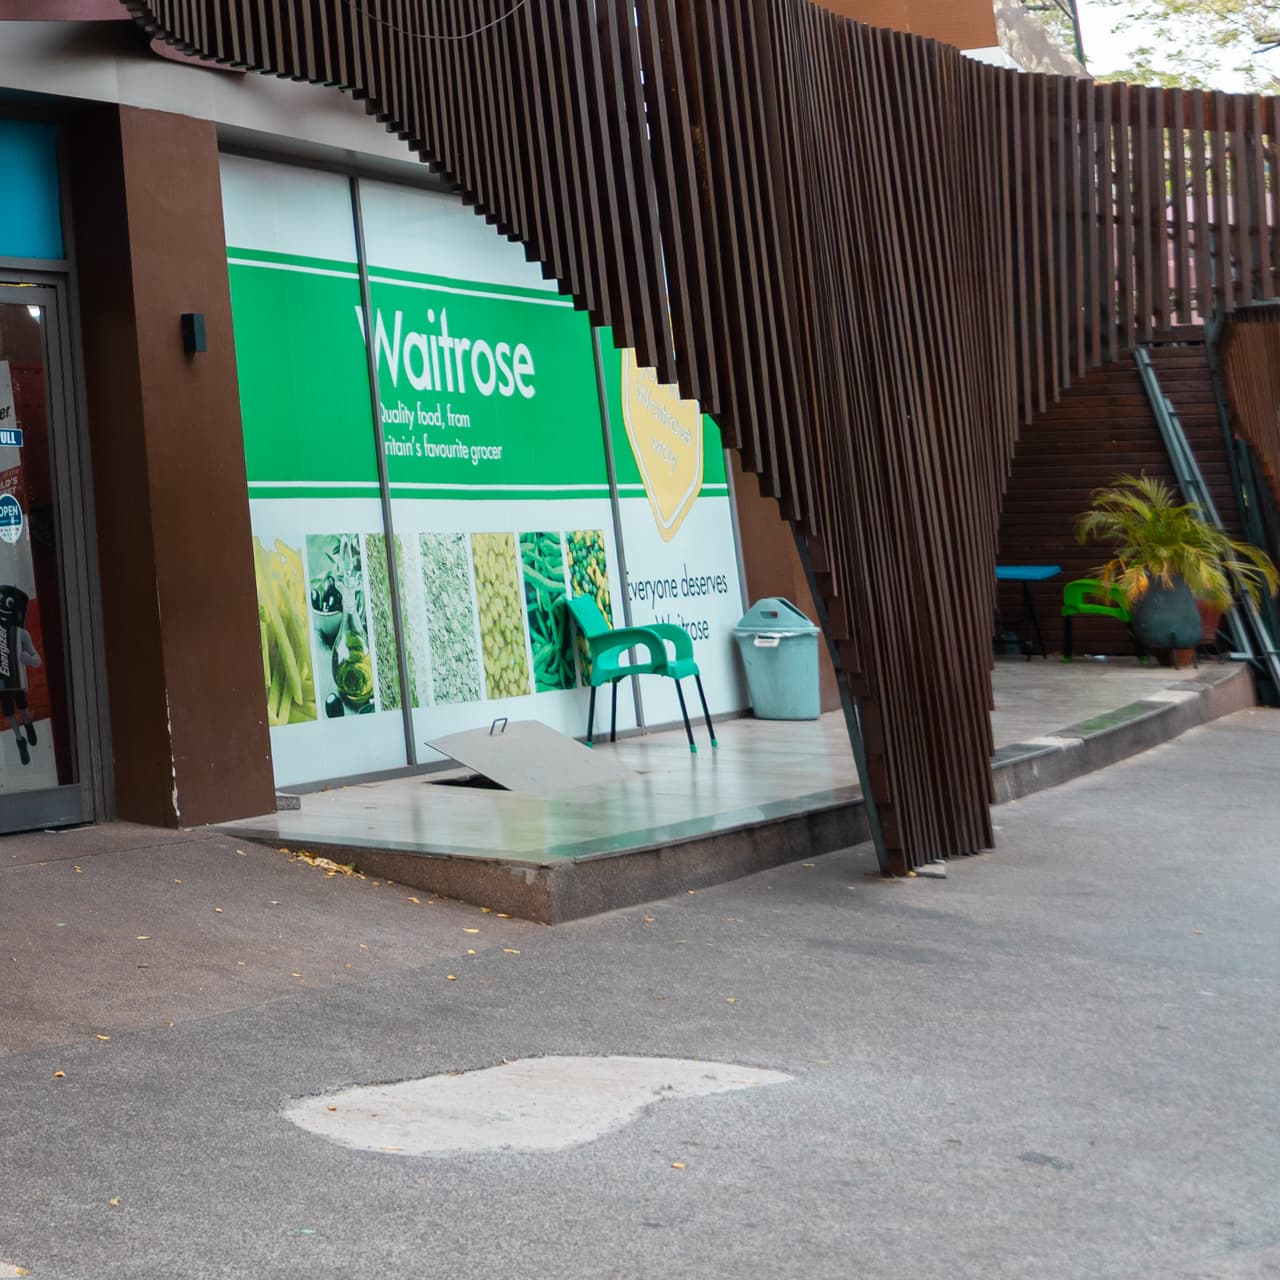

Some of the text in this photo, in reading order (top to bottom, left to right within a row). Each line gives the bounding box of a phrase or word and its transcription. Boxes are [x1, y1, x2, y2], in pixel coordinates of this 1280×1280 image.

[354, 305, 536, 399] Waitrose
[416, 401, 445, 430] food,
[447, 403, 471, 428] from
[634, 377, 692, 447] Waitrose
[384, 433, 503, 465] ritain's favourite grocer
[680, 563, 728, 598] deserves
[654, 613, 710, 642] trose
[0, 625, 11, 677] Energizer
